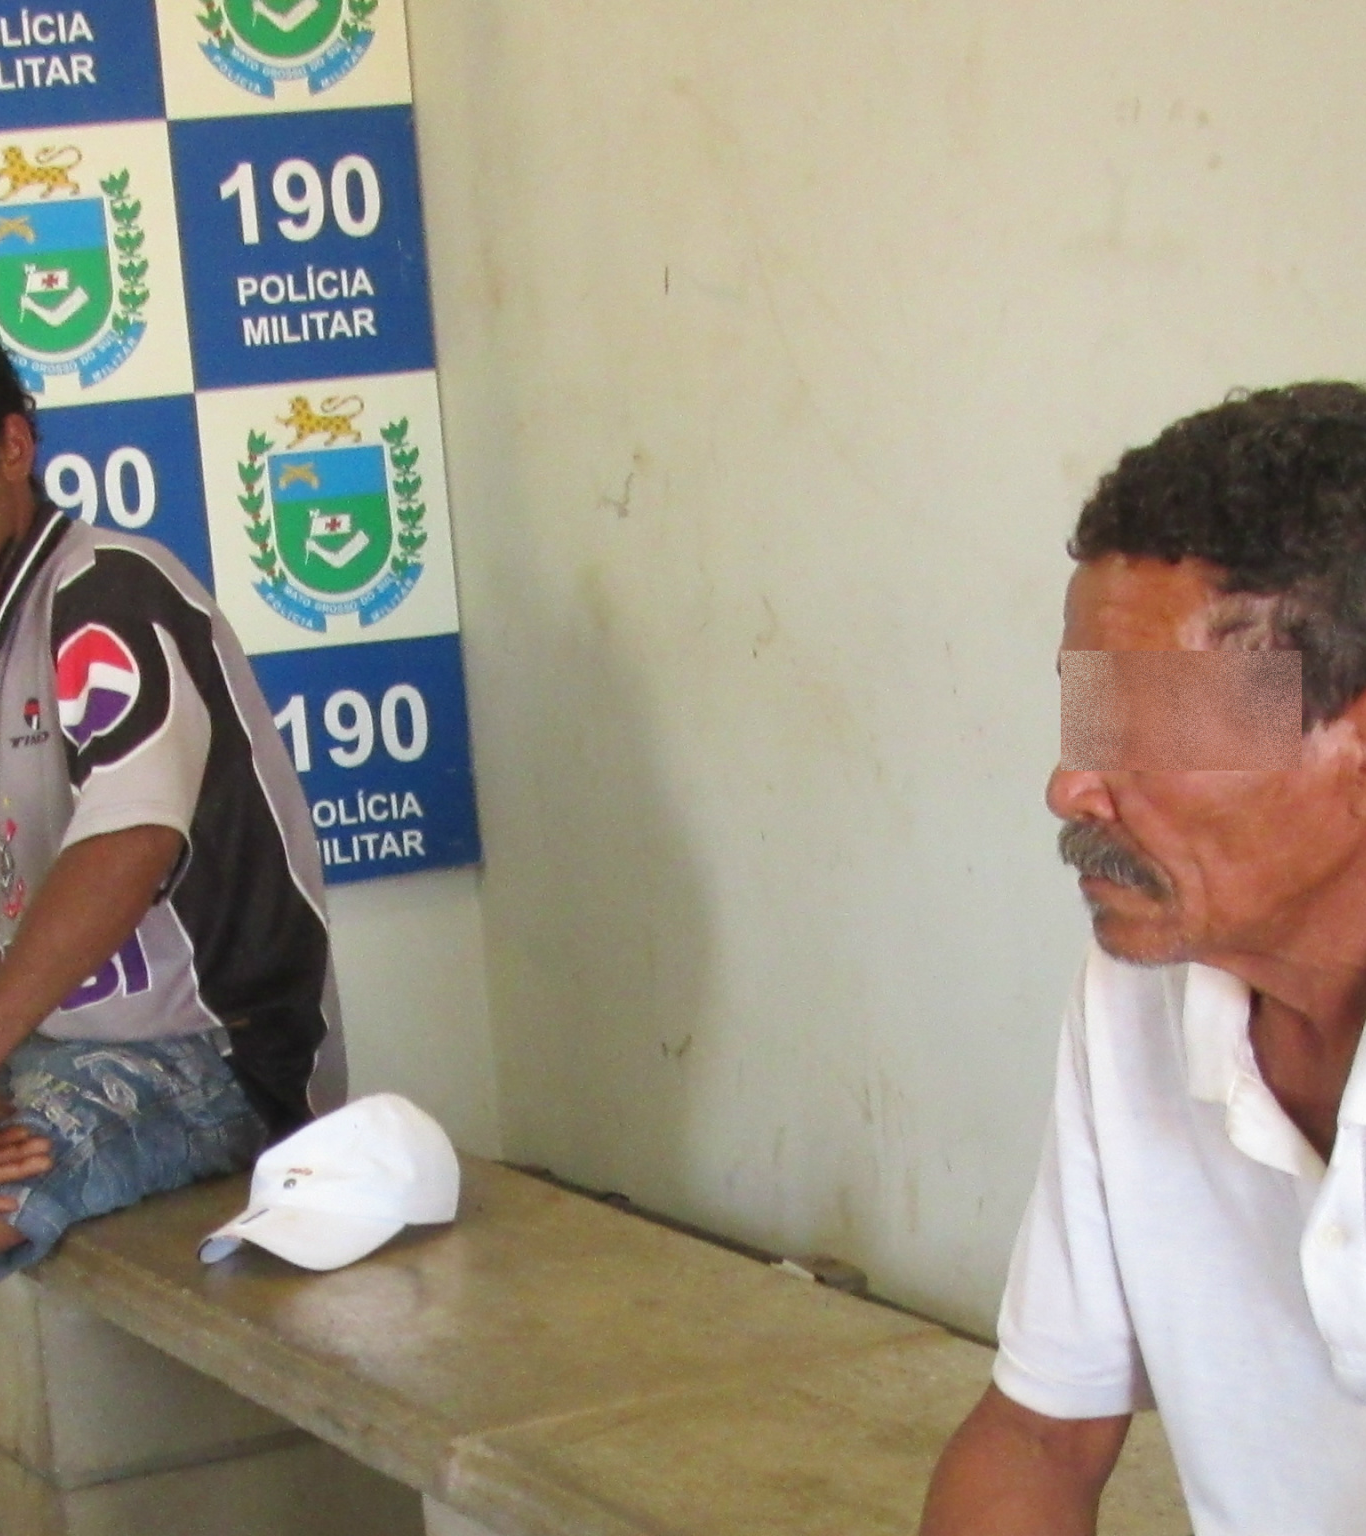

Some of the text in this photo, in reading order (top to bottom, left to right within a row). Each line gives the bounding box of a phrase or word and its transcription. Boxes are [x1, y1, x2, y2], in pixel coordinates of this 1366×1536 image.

[220, 155, 380, 244] 190
[238, 266, 373, 305] POLÍCIA
[243, 308, 376, 346] MILITAR
[44, 447, 155, 528] 90
[273, 684, 428, 772] 190
[313, 789, 422, 827] OLÍCIA
[317, 830, 424, 865] ILITAR
